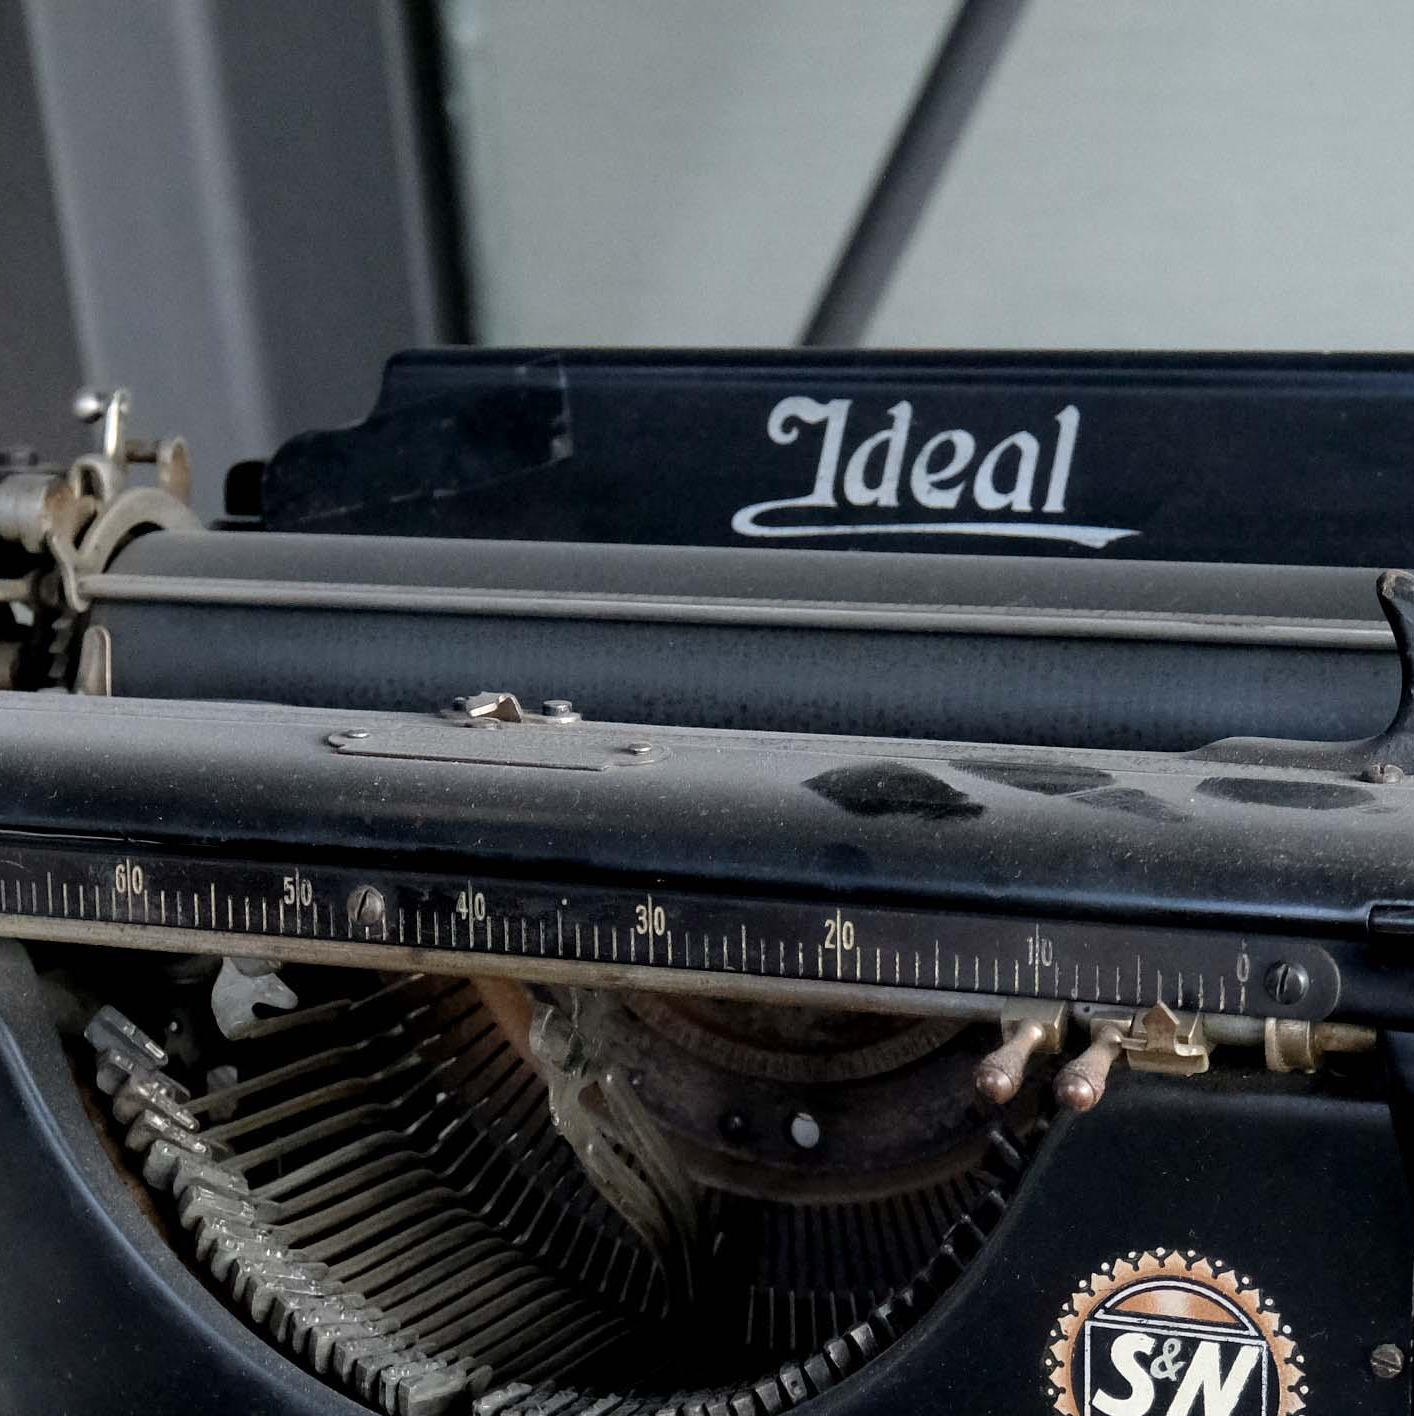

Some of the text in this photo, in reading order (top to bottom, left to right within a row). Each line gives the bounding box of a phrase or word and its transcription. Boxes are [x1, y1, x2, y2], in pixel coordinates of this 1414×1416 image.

[731, 396, 1143, 549] Ideal
[115, 862, 143, 896] 60
[284, 874, 313, 908] 50
[456, 890, 486, 923] 40
[635, 903, 666, 938] 30
[824, 918, 855, 952] 20
